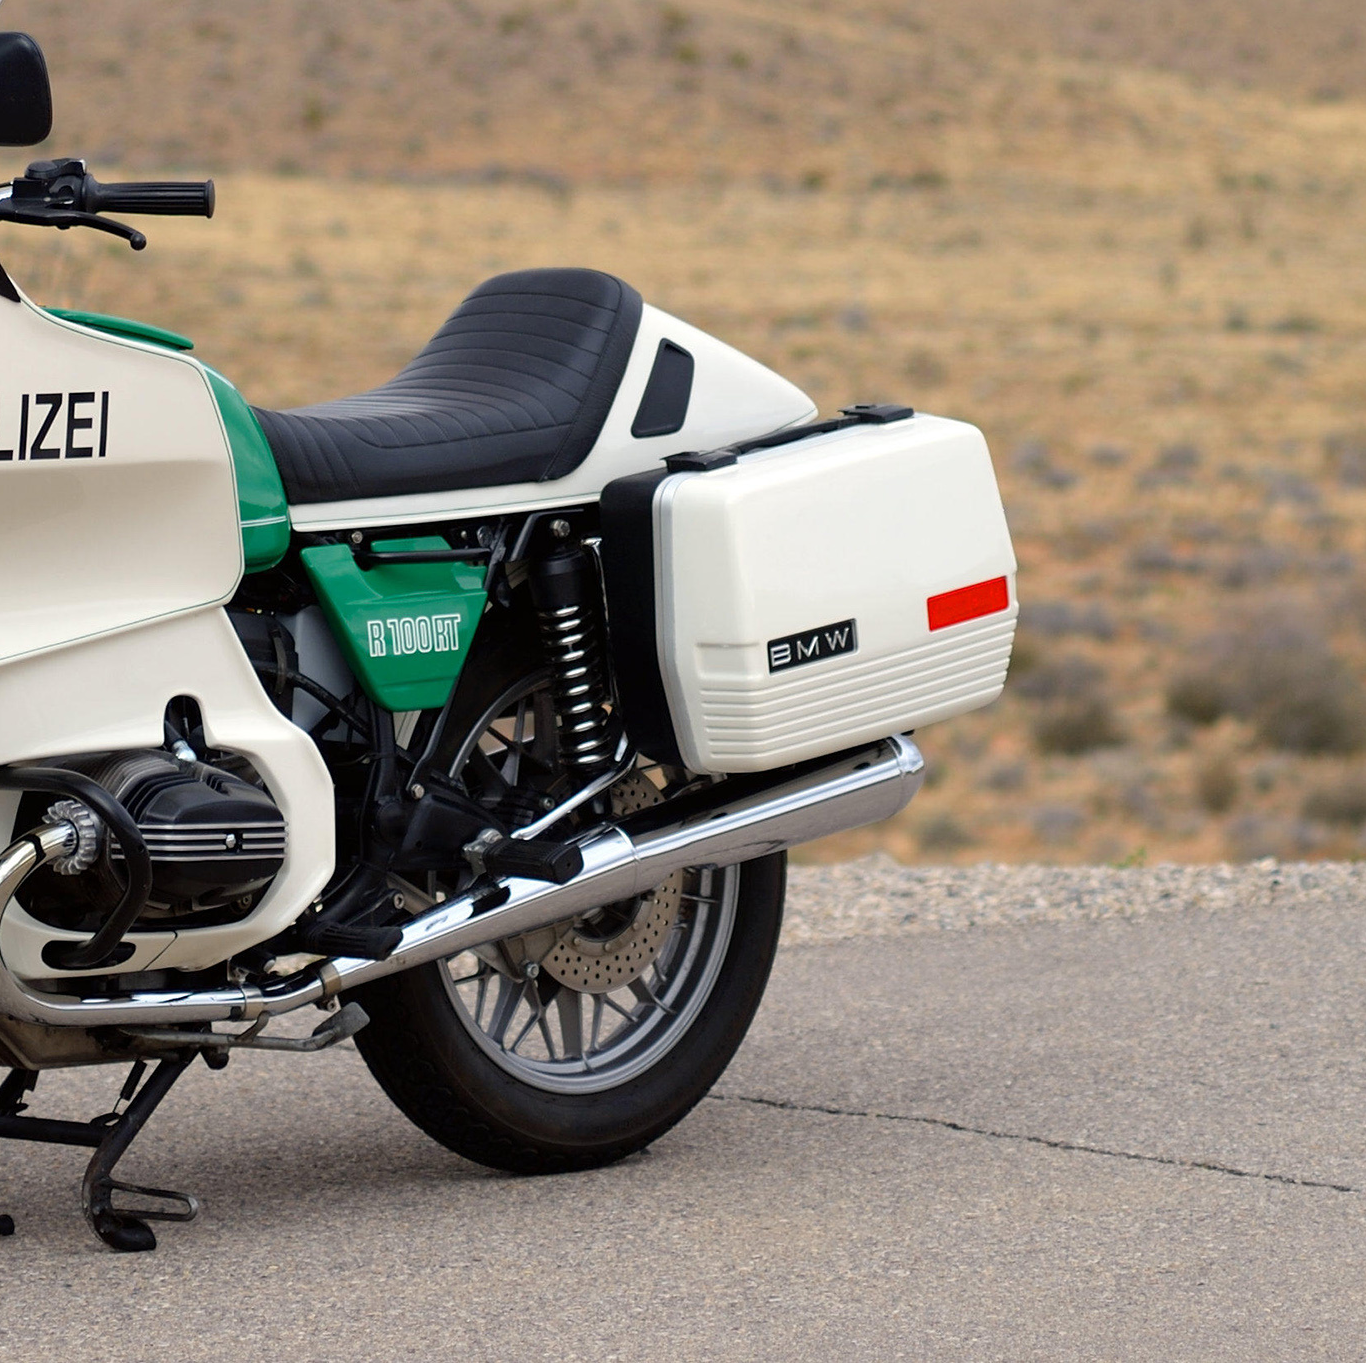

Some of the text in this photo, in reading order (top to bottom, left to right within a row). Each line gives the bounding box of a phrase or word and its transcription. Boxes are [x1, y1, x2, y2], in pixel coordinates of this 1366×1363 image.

[367, 614, 461, 657] R 100RT
[770, 627, 849, 667] BMW
